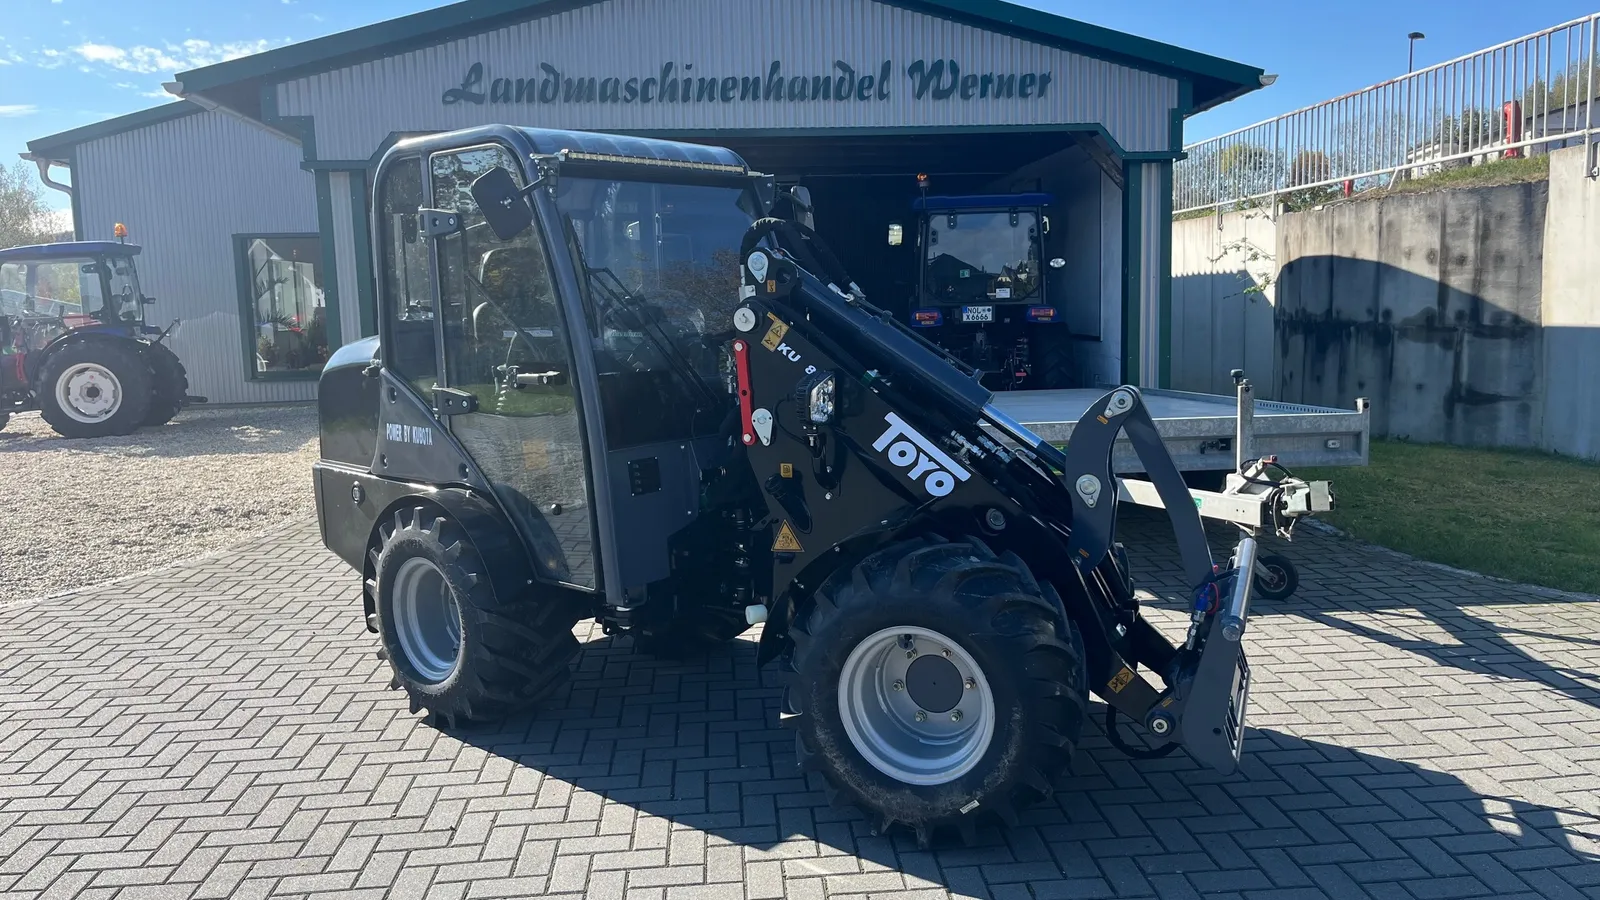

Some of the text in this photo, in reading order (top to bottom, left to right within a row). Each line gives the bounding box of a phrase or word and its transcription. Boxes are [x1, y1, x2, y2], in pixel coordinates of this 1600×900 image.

[442, 59, 1051, 103] Landmaschinenhandel Werner
[777, 342, 801, 362] KU
[386, 423, 433, 446] POWER BY KUBOTA
[872, 411, 971, 497] TOYO
